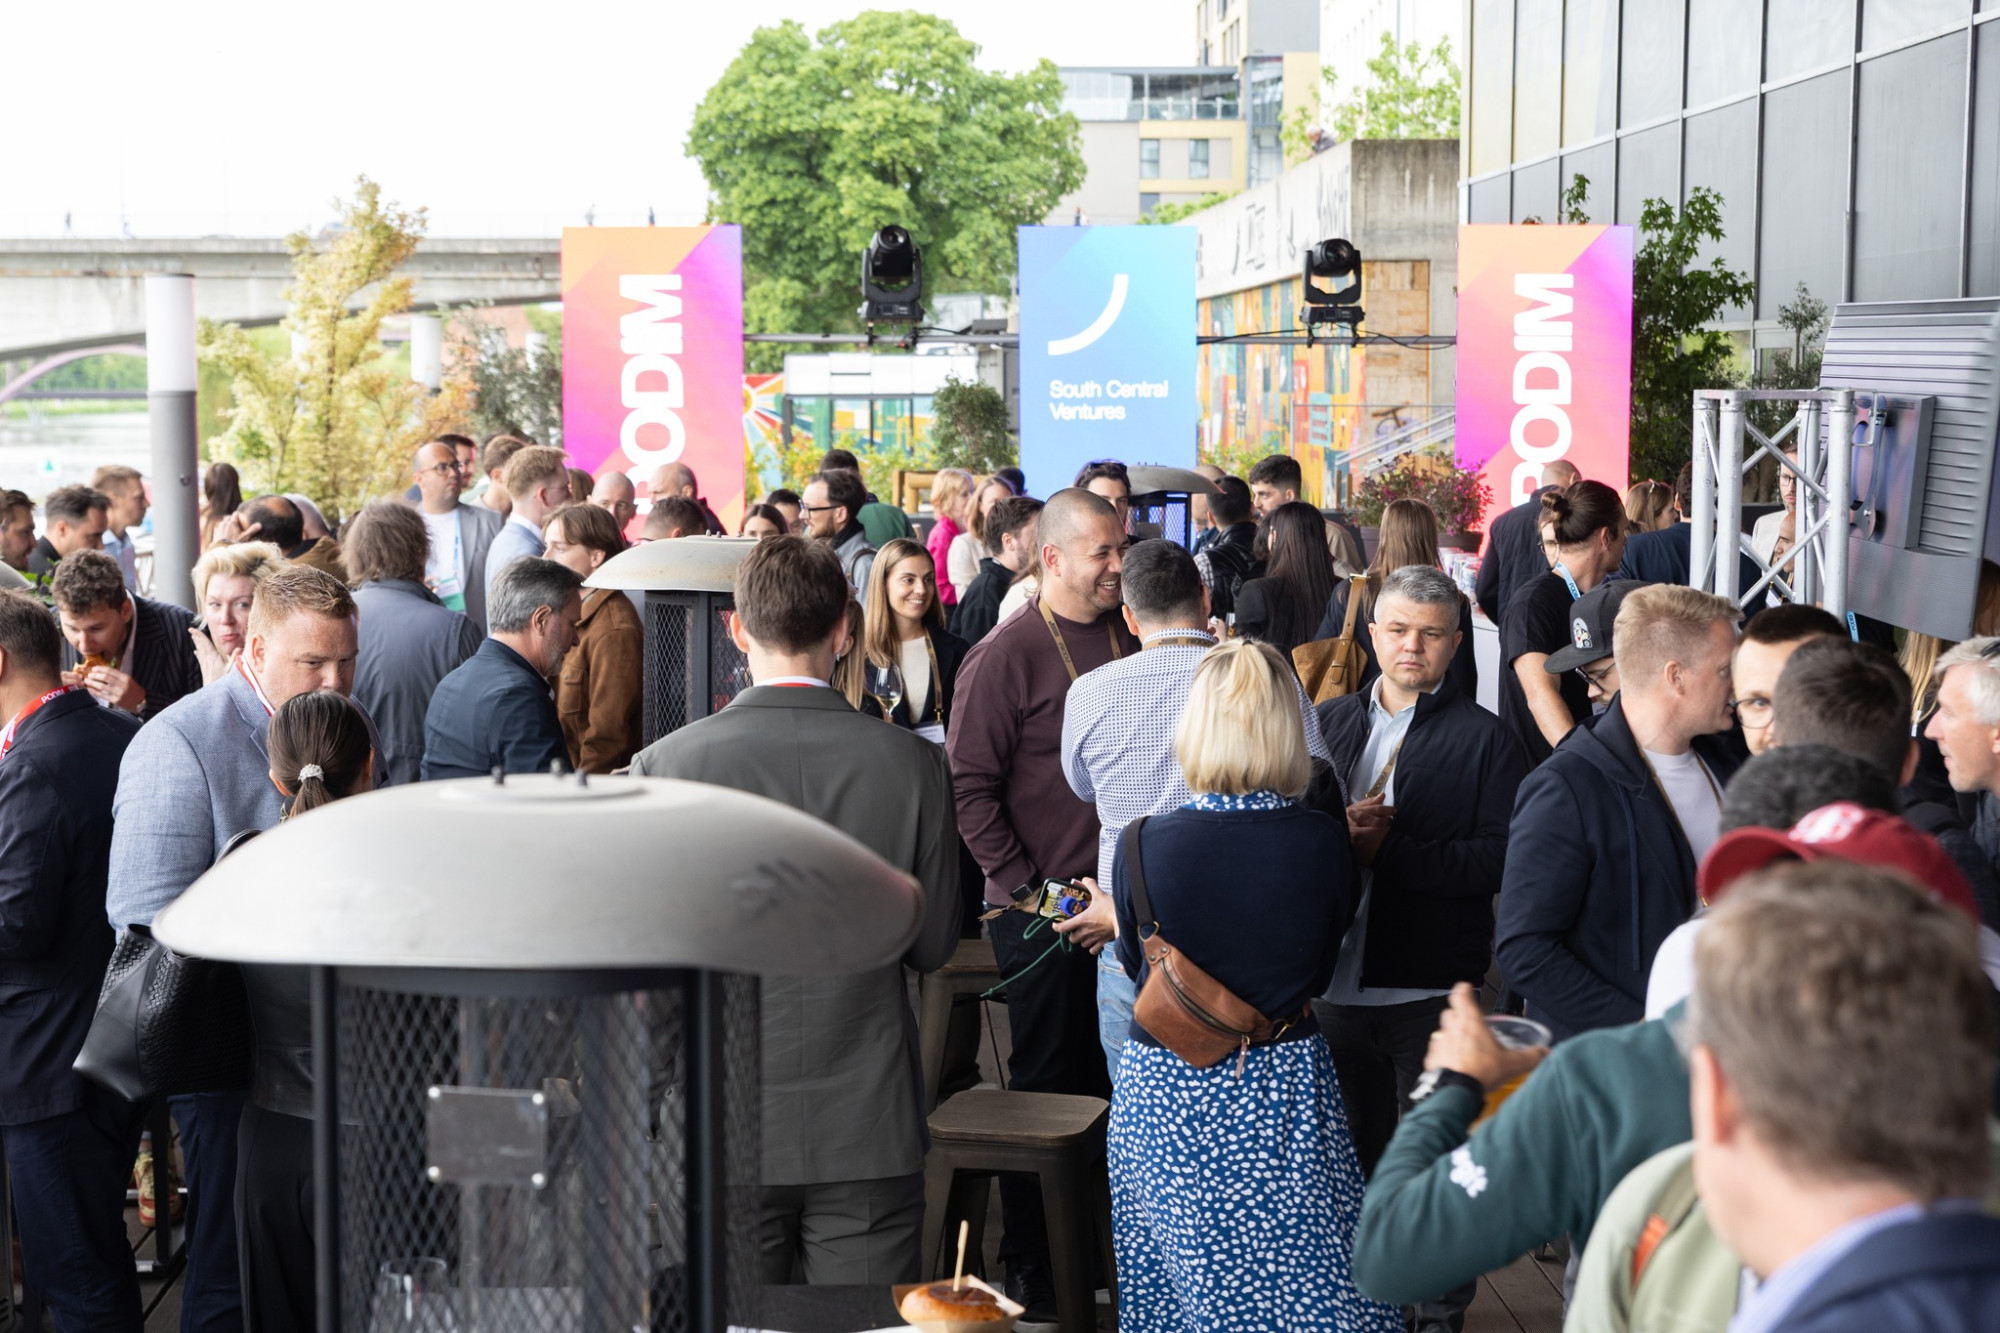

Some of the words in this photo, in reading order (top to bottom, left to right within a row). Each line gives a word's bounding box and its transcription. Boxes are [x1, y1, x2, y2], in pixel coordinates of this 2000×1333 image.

[1049, 380, 1101, 398] South
[1106, 380, 1168, 398] Central
[1049, 403, 1126, 420] Ventures
